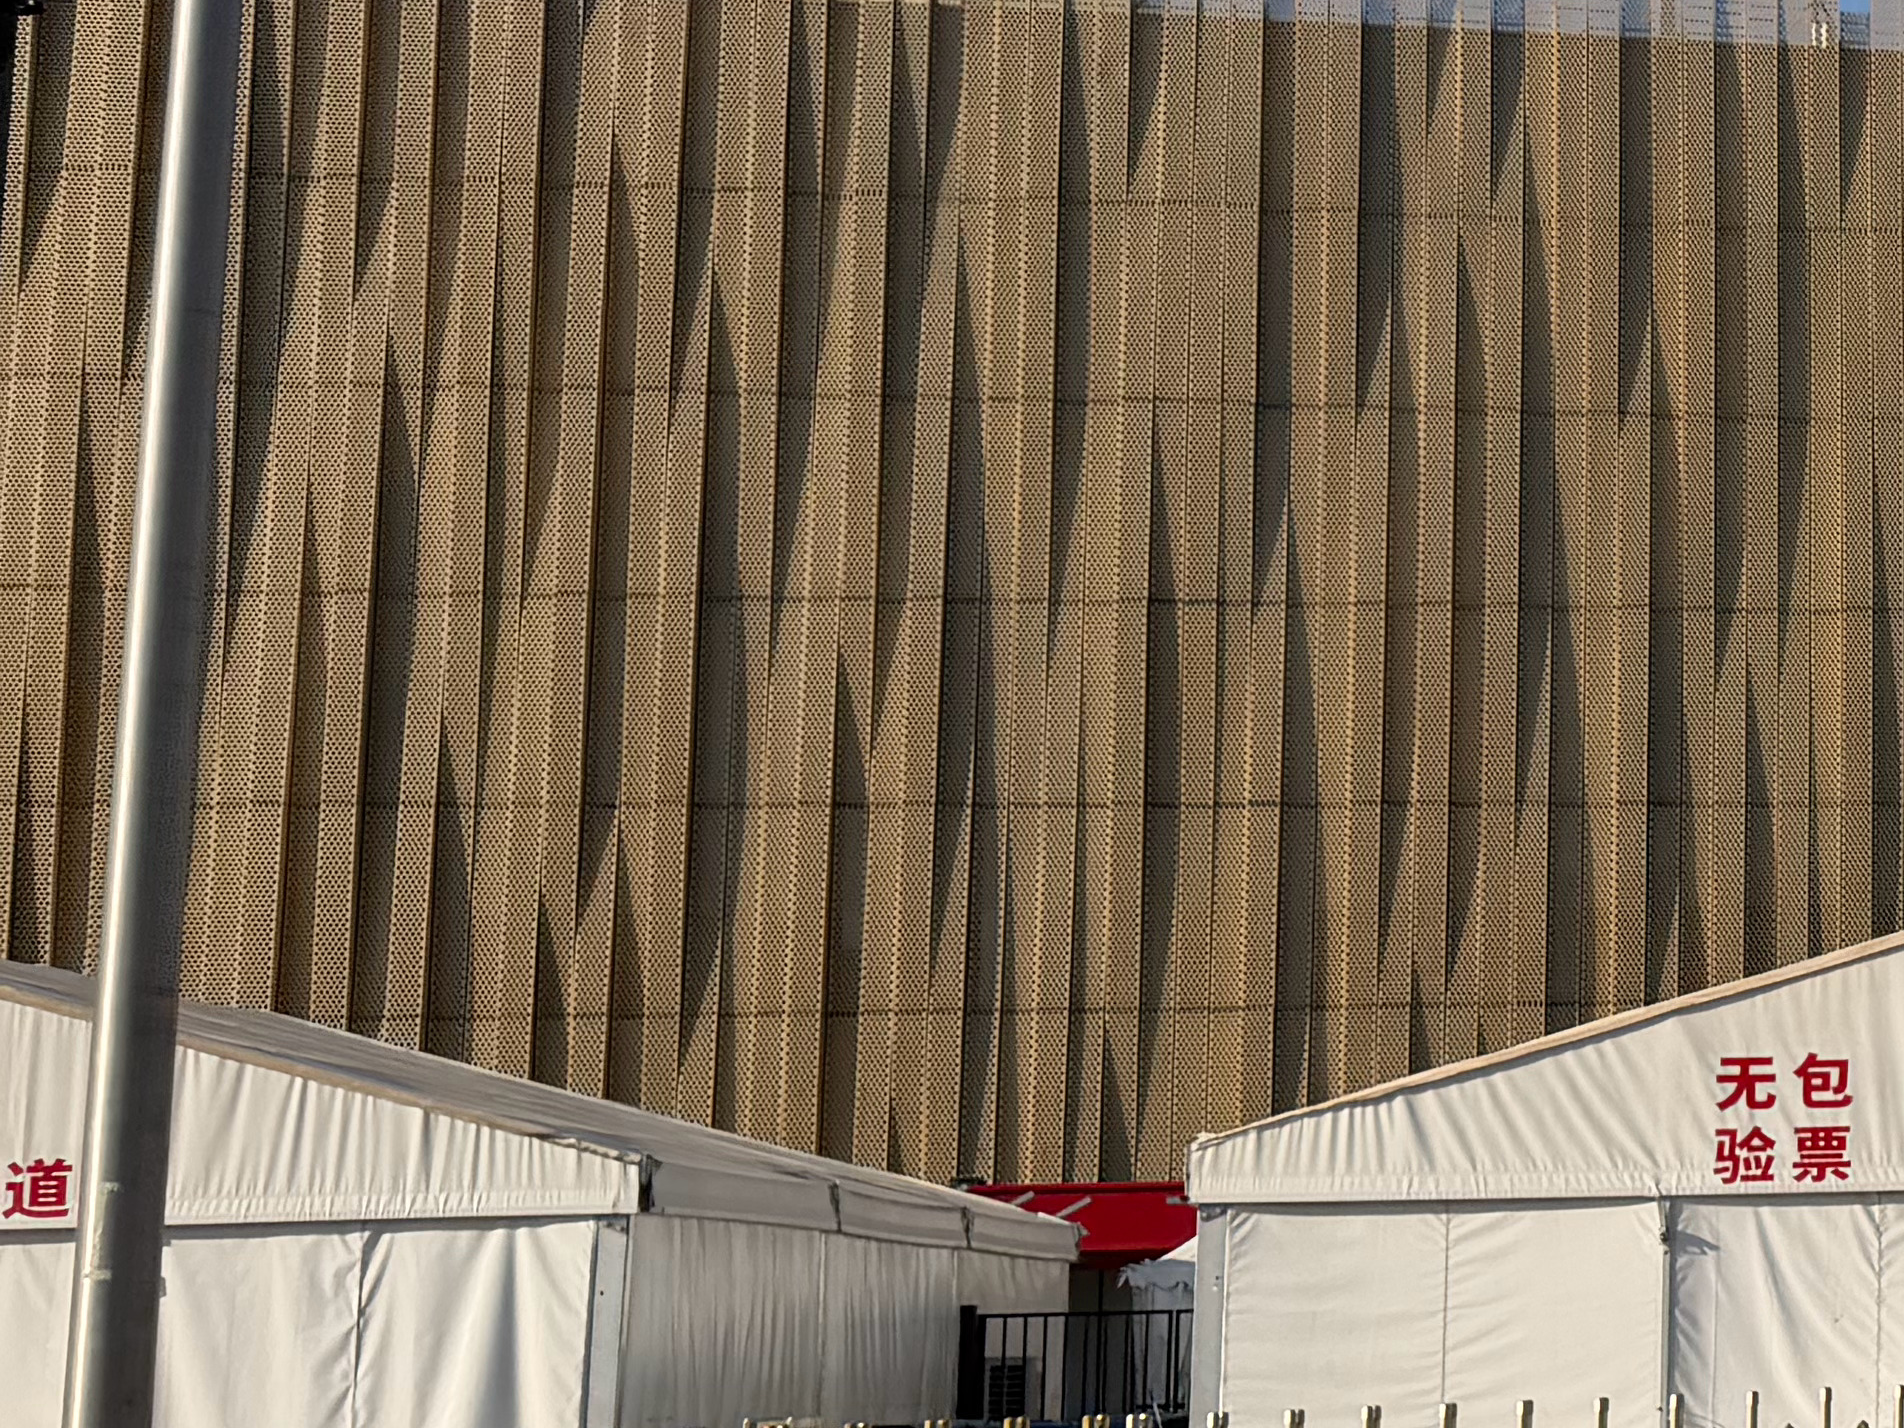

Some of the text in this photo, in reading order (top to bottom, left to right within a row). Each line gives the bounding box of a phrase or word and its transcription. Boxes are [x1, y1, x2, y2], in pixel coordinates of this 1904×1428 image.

[1715, 1053, 1853, 1112] 无包
[1714, 1125, 1853, 1185] 验票
[2, 1159, 73, 1219] 道
